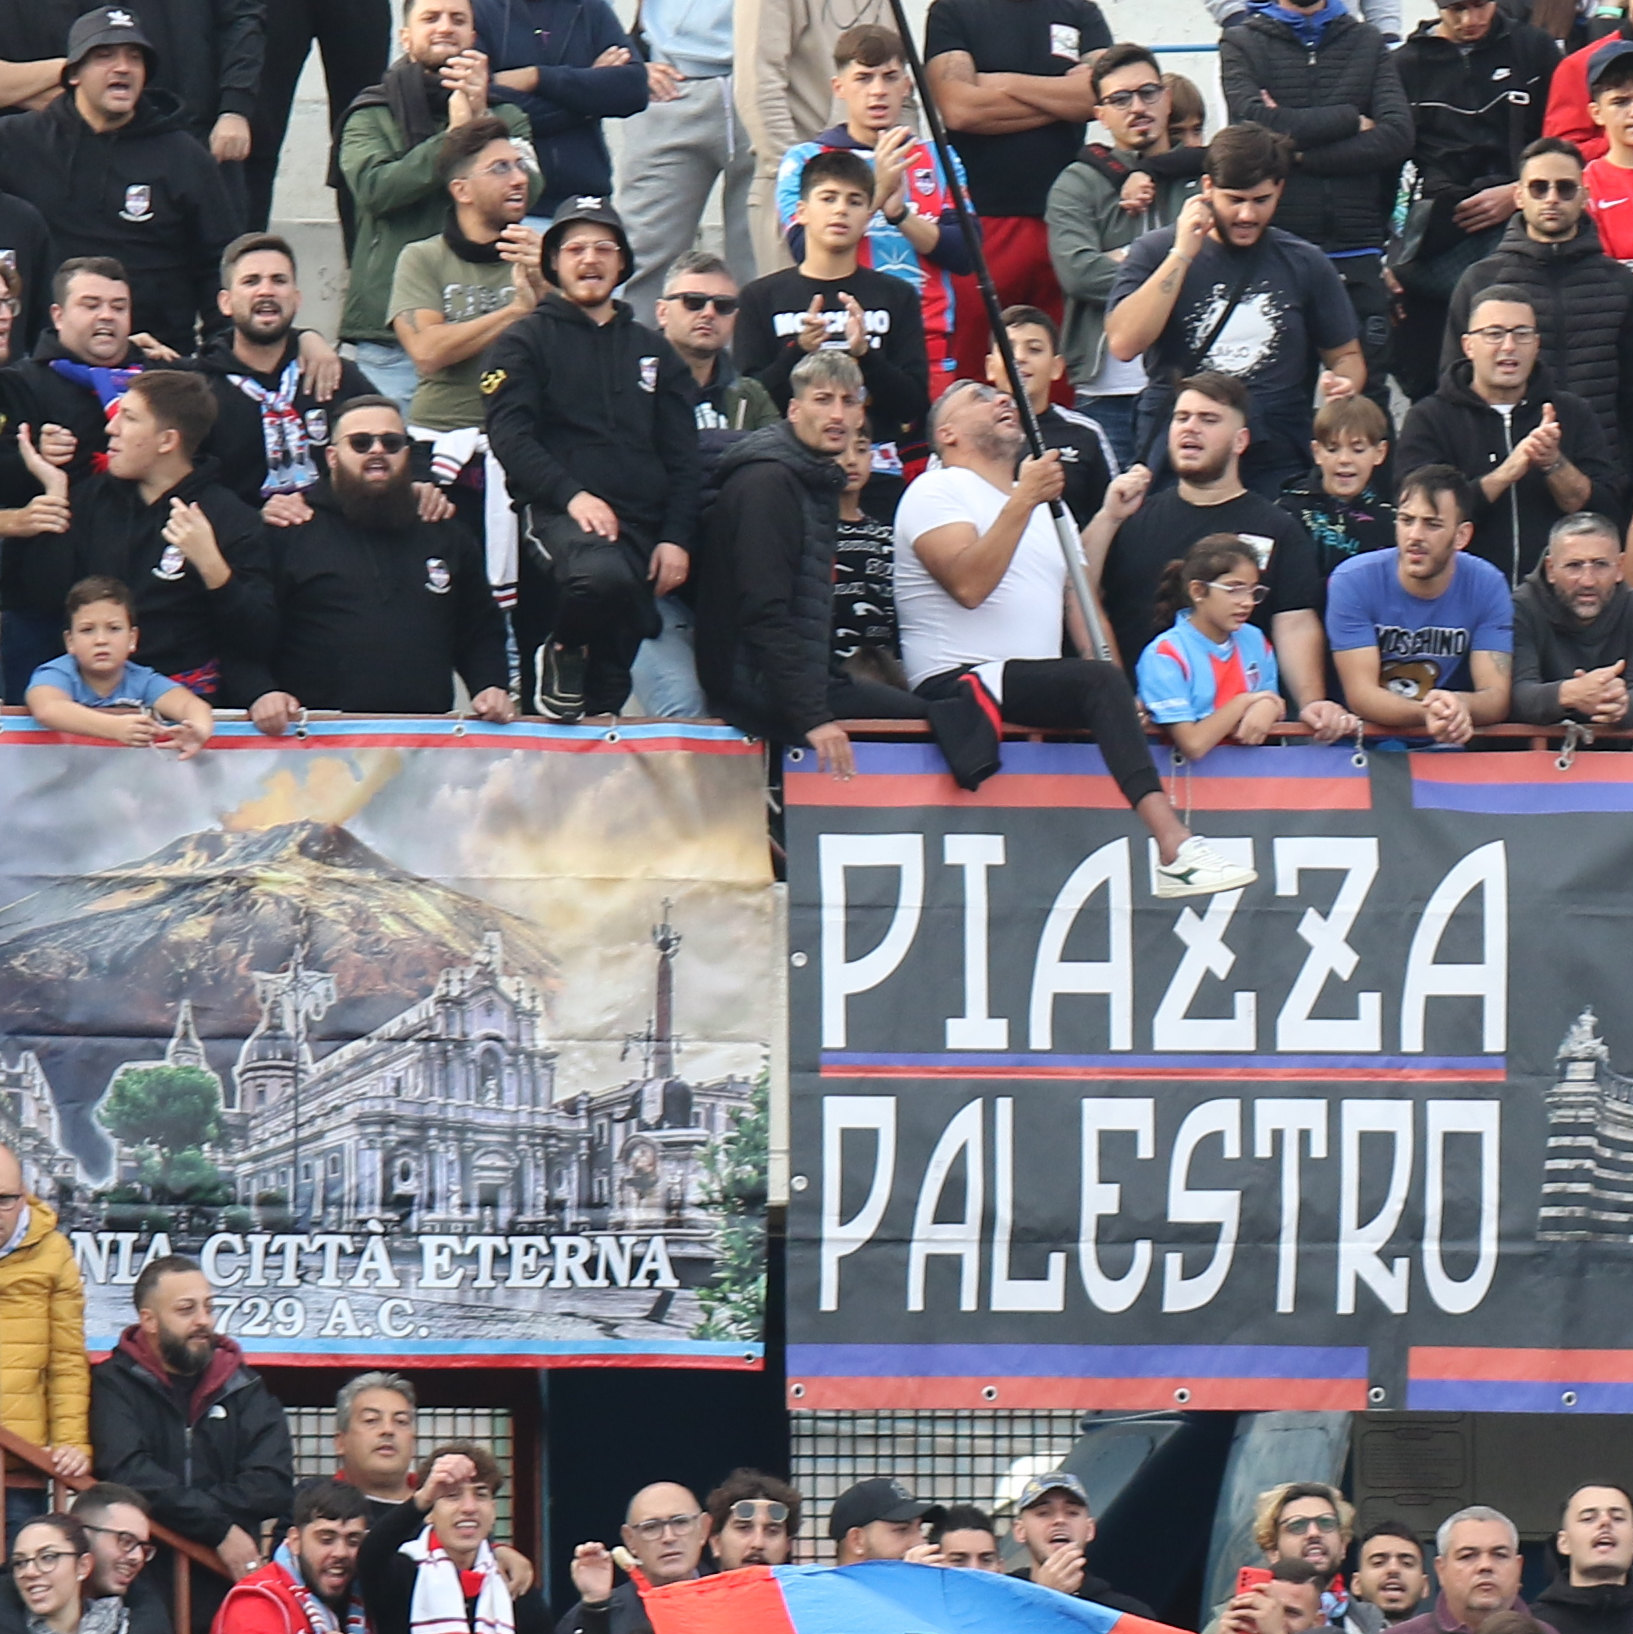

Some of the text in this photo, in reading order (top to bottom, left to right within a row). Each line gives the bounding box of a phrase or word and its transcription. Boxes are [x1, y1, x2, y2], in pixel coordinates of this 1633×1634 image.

[819, 834, 1509, 1053] PIAZZA
[201, 1220, 401, 1290] CITTÀ
[418, 1235, 681, 1290] ETERNA
[819, 1096, 1502, 1315] PALESTRO
[321, 1297, 431, 1340] A.C.
